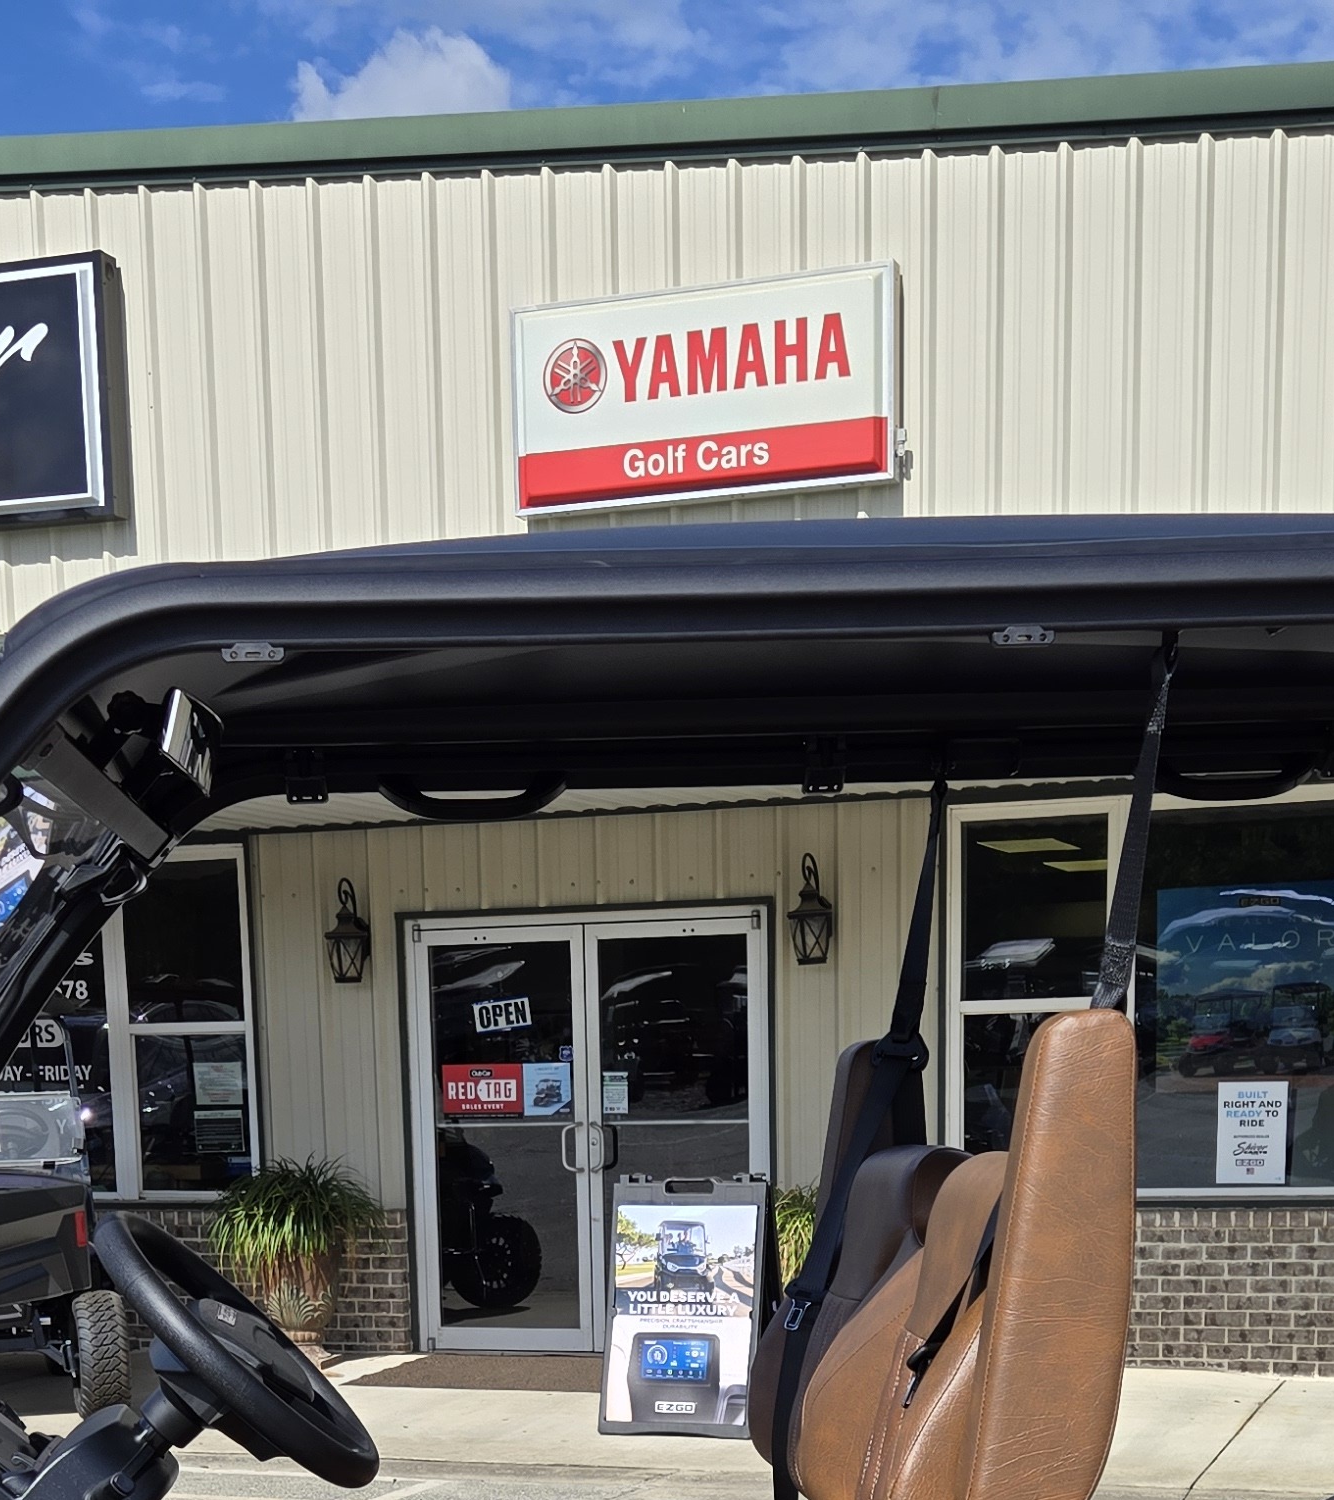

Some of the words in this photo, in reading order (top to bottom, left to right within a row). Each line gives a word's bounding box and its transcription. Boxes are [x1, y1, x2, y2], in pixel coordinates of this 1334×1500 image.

[612, 311, 852, 403] YAMAHA
[623, 443, 687, 478] Golf
[696, 440, 770, 472] Cars
[478, 1000, 527, 1029] OPEN
[447, 1081, 476, 1100] RED
[485, 1082, 512, 1099] TAG
[1238, 1091, 1268, 1099] BUILT
[1226, 1110, 1262, 1118] READY
[627, 1290, 657, 1302] YOU
[659, 1291, 725, 1303] DESERVE
[728, 1292, 741, 1304] A
[629, 1303, 674, 1315] LITTLE
[677, 1304, 738, 1317] LUXURY
[657, 1403, 693, 1412] EZGO
